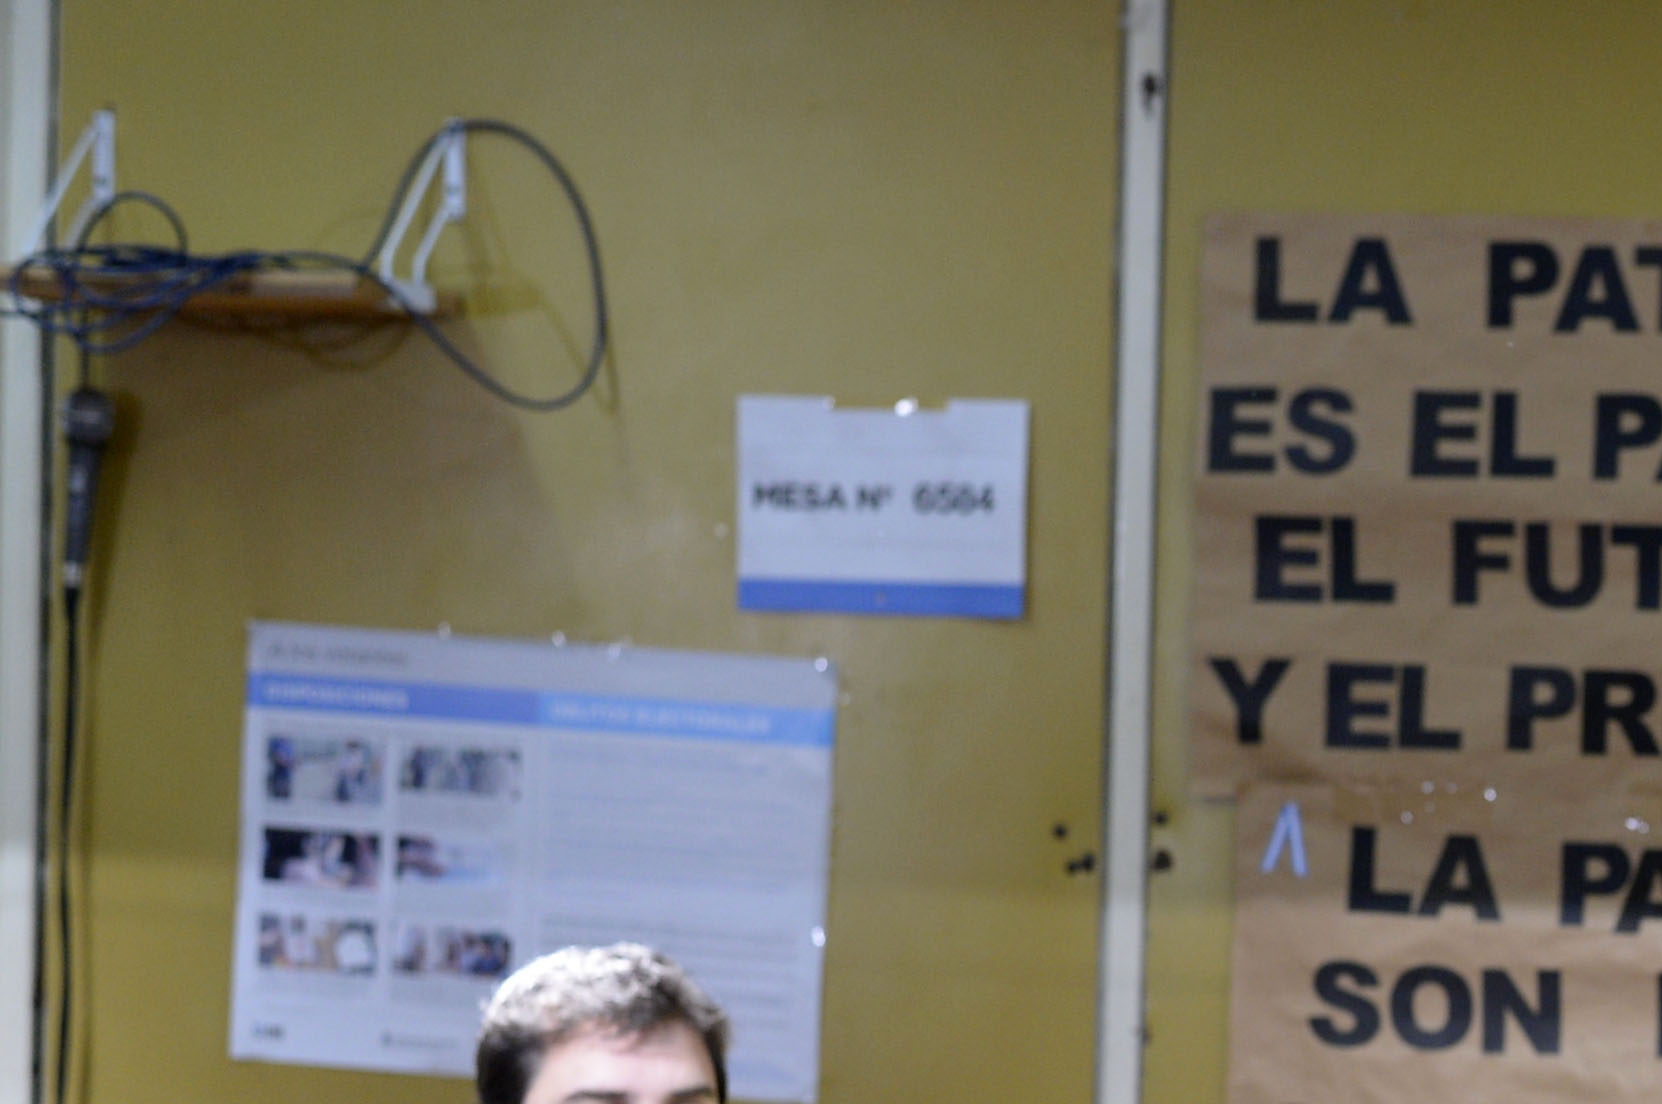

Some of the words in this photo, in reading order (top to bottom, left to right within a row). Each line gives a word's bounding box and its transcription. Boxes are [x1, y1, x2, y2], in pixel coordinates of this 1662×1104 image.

[1253, 235, 1413, 326] LA
[1207, 386, 1357, 476] ES
[1409, 389, 1556, 479] EL
[752, 481, 847, 512] MESA
[1253, 513, 1396, 604] EL
[1208, 657, 1292, 747] Y
[1324, 661, 1463, 751] EL
[1347, 823, 1499, 921] LA
[1308, 959, 1563, 1055] SON
